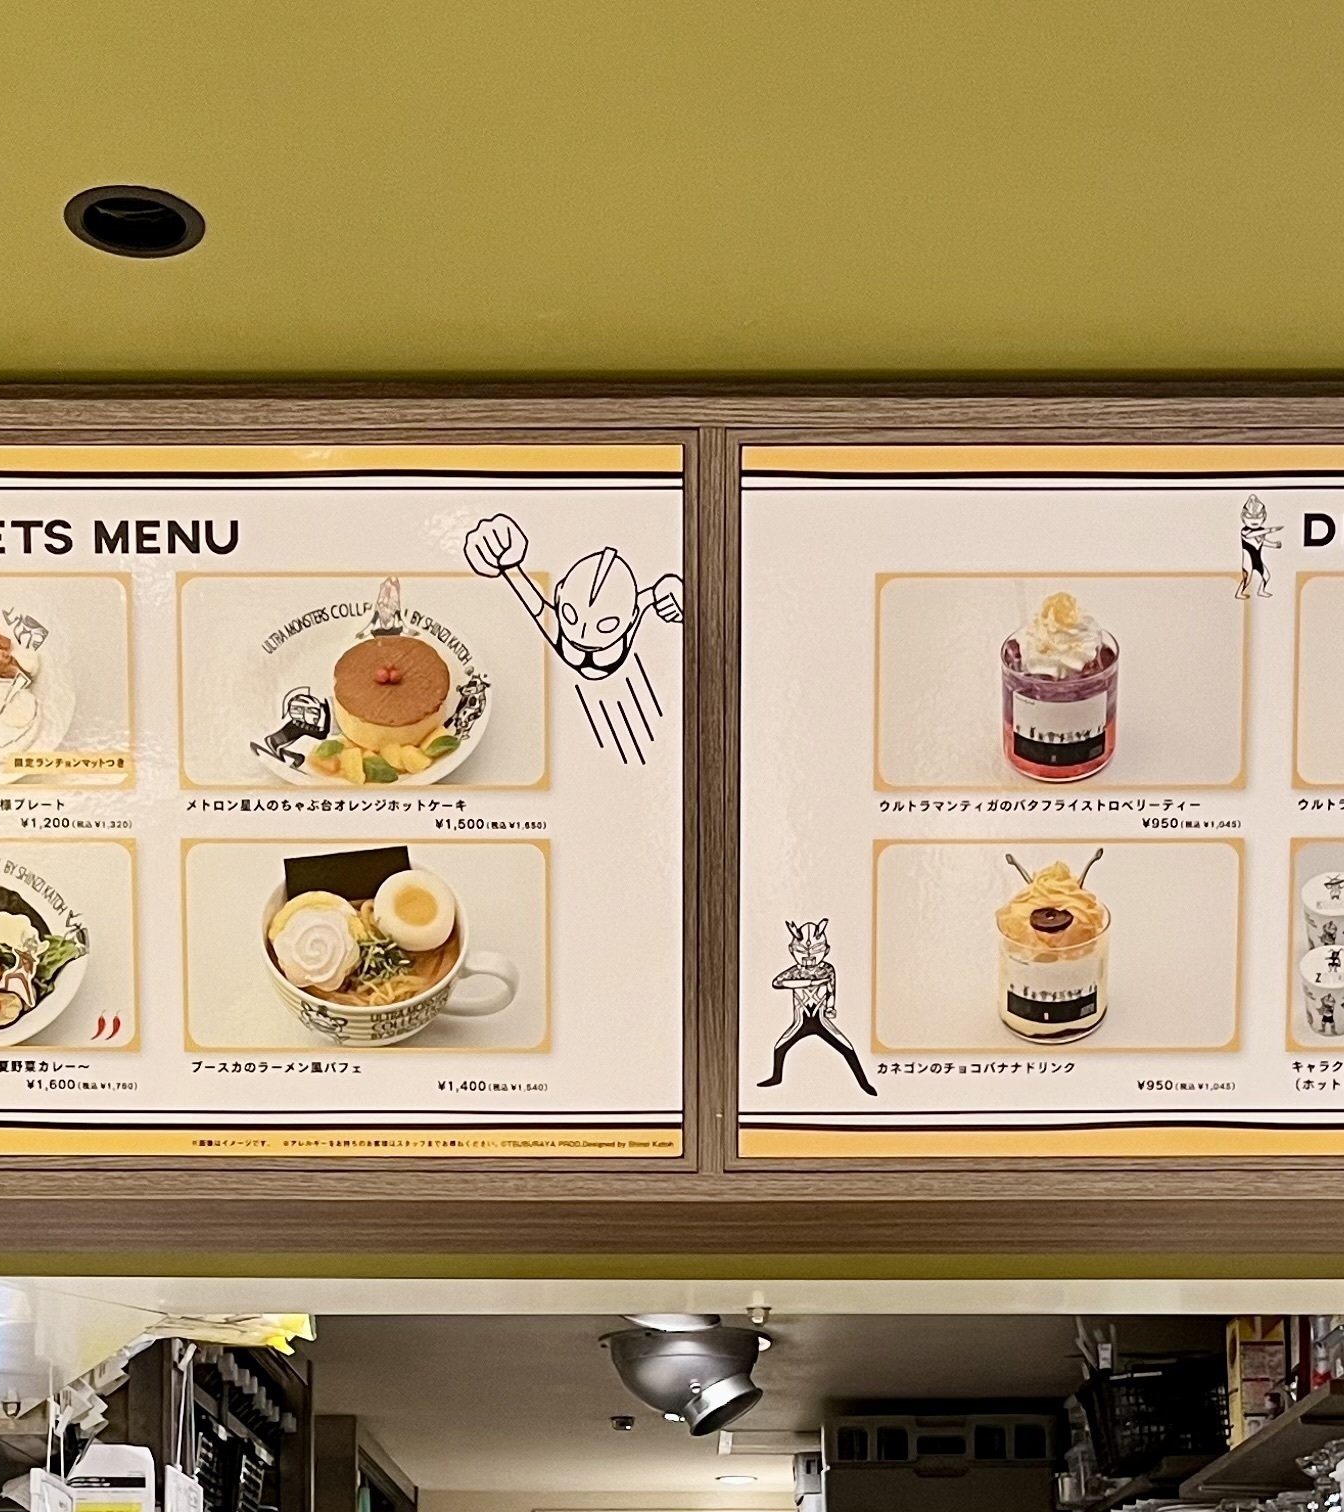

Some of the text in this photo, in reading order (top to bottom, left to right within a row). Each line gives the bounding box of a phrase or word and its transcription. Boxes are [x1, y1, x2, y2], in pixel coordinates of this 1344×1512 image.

[93, 519, 240, 555] MENU
[20, 817, 70, 829] ¥1,200
[435, 818, 485, 830] ¥1,500
[1142, 817, 1179, 830] ¥950
[877, 1060, 1076, 1075] カネゴンのチョコバナナドリンク
[26, 1079, 76, 1092] ¥1,600
[437, 1079, 487, 1093] ¥1,400
[1137, 1079, 1173, 1092] ¥950
